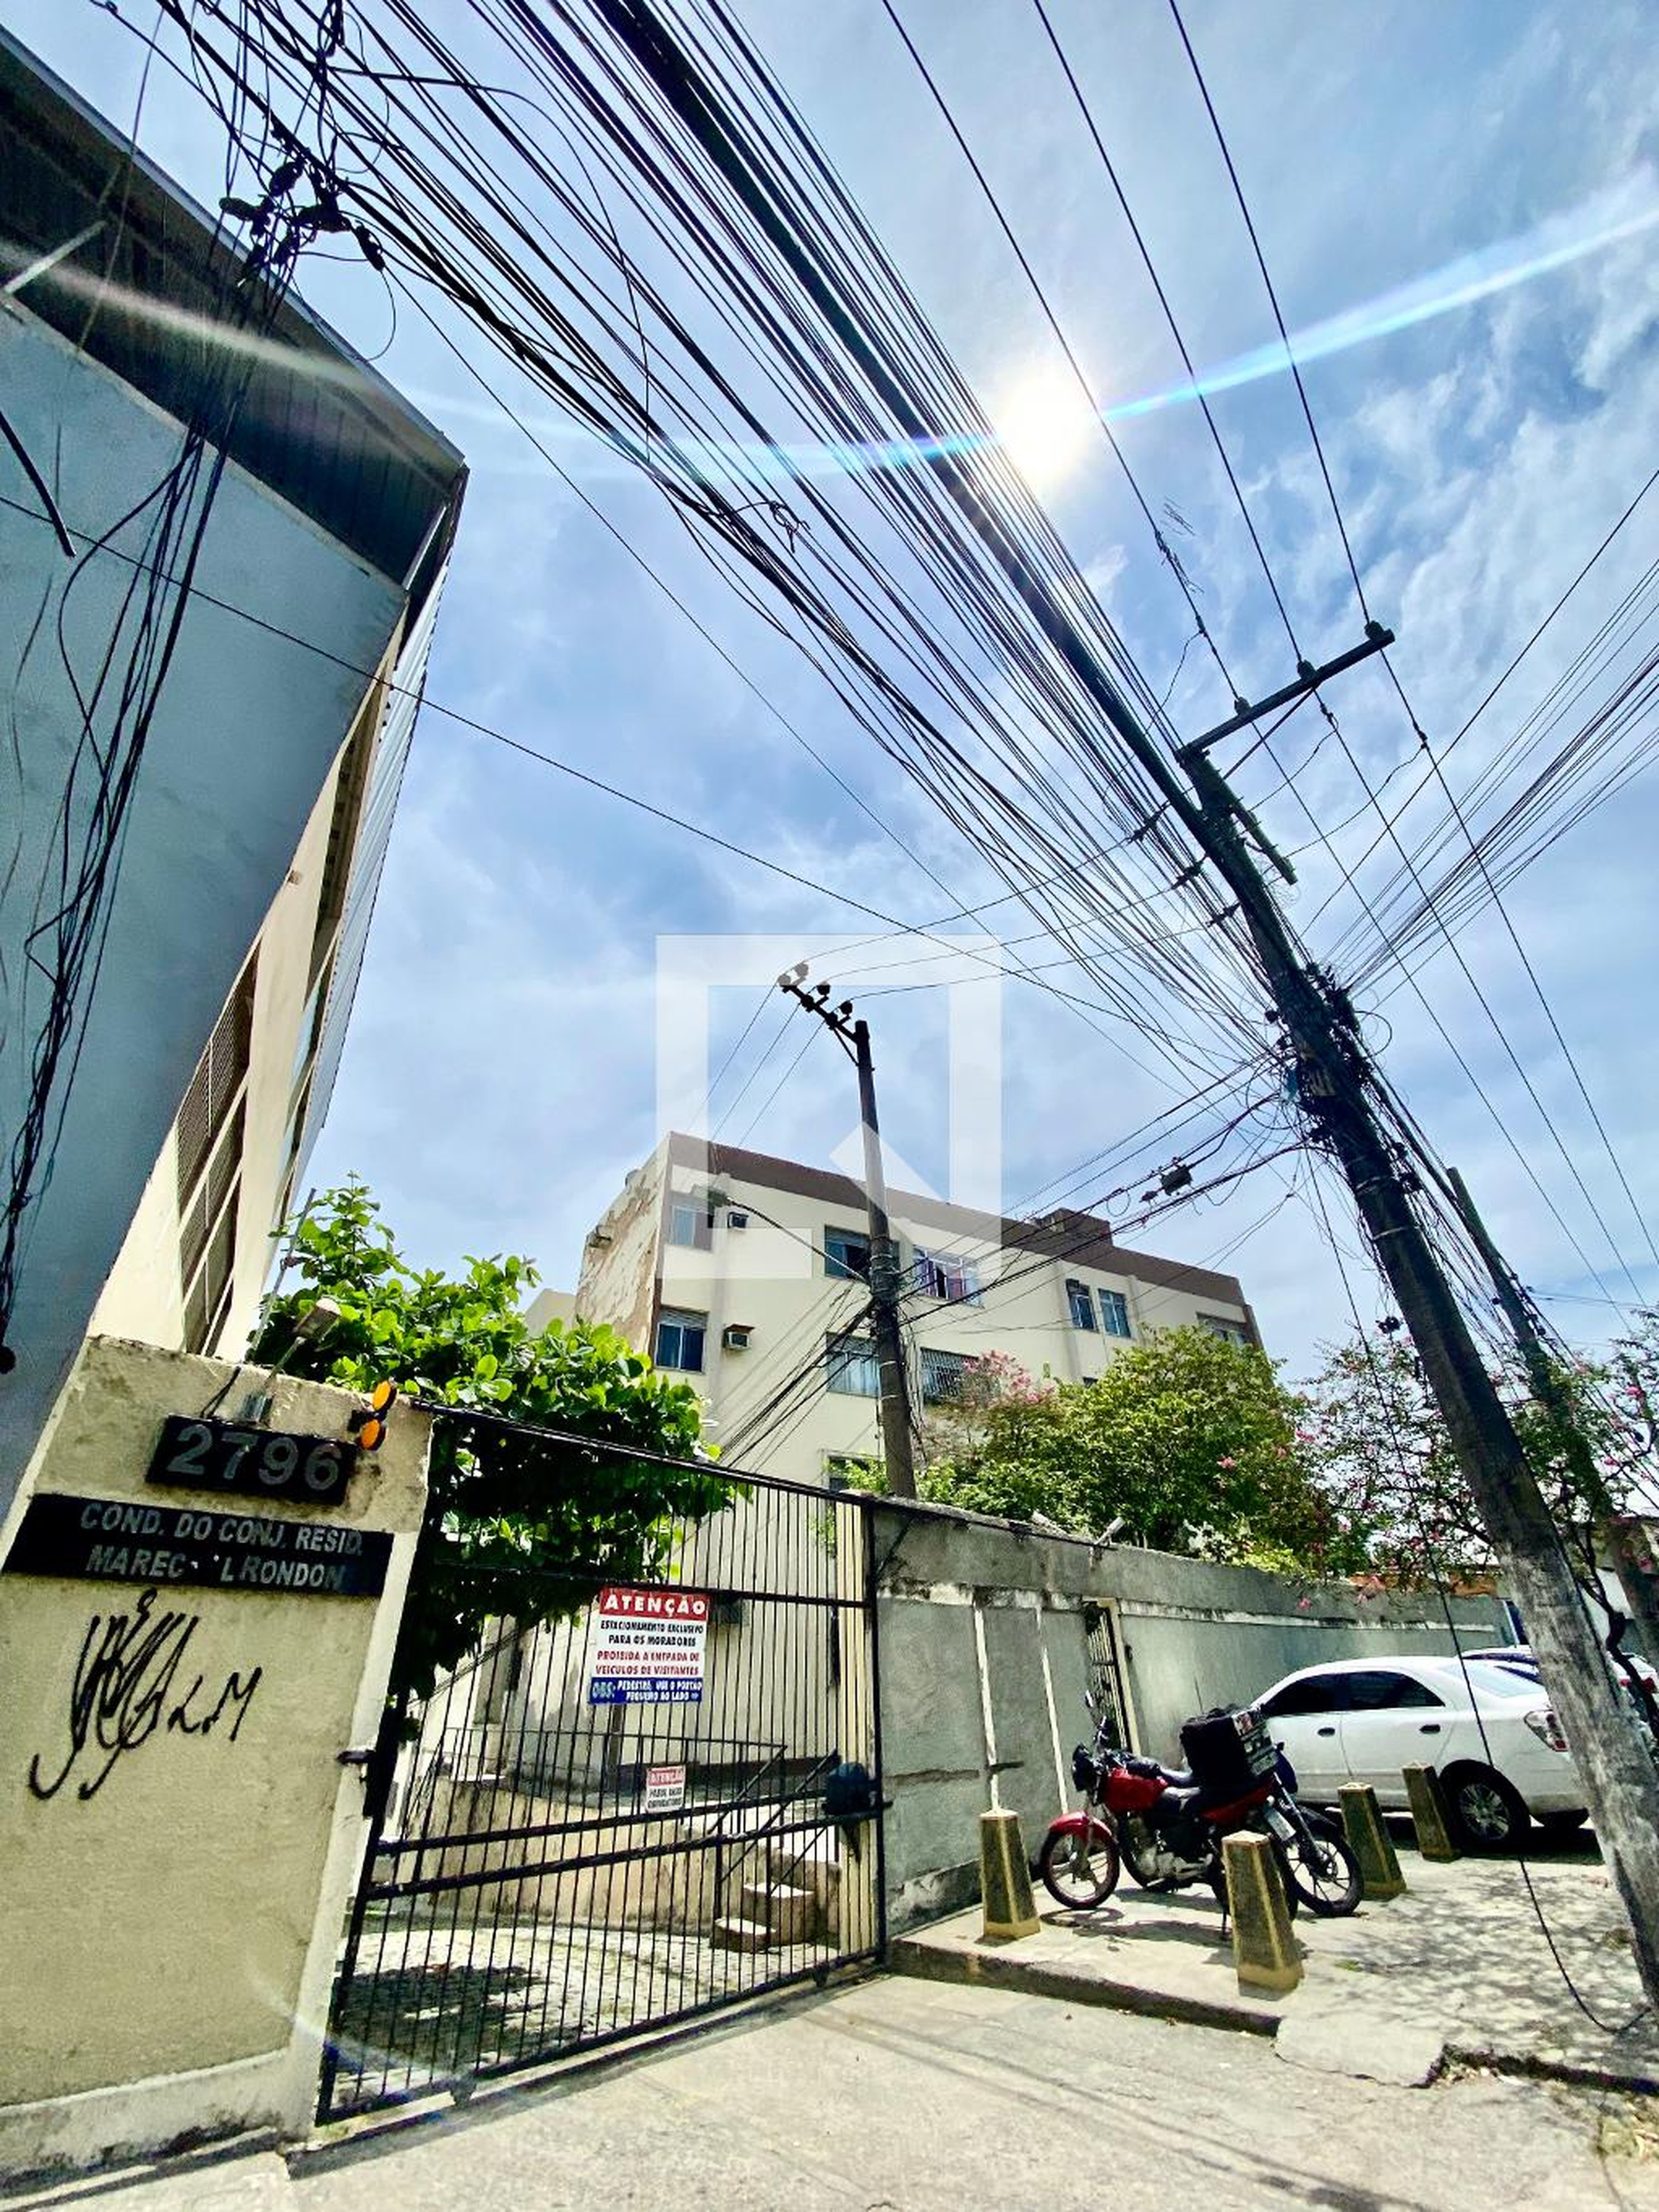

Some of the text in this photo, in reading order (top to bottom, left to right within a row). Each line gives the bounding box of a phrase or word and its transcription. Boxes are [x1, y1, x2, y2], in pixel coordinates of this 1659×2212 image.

[167, 1424, 342, 1491] 2796
[80, 1503, 164, 1535] COND.
[174, 1513, 213, 1540] DO
[218, 1520, 286, 1550] CONJ.
[238, 1556, 345, 1590] RONDON
[604, 1594, 706, 1617] ATENÇÃO
[601, 1620, 704, 1634] ESTACIONAMENTO EXCLUSIVO
[608, 1635, 696, 1647] PARA OS MORADORES
[597, 1651, 699, 1661] PROIBIDA A ENTRADA DE
[641, 1665, 651, 1675] DE
[654, 1665, 699, 1675] VISITANTES
[660, 1691, 670, 1700] AO
[671, 1691, 689, 1701] LADO
